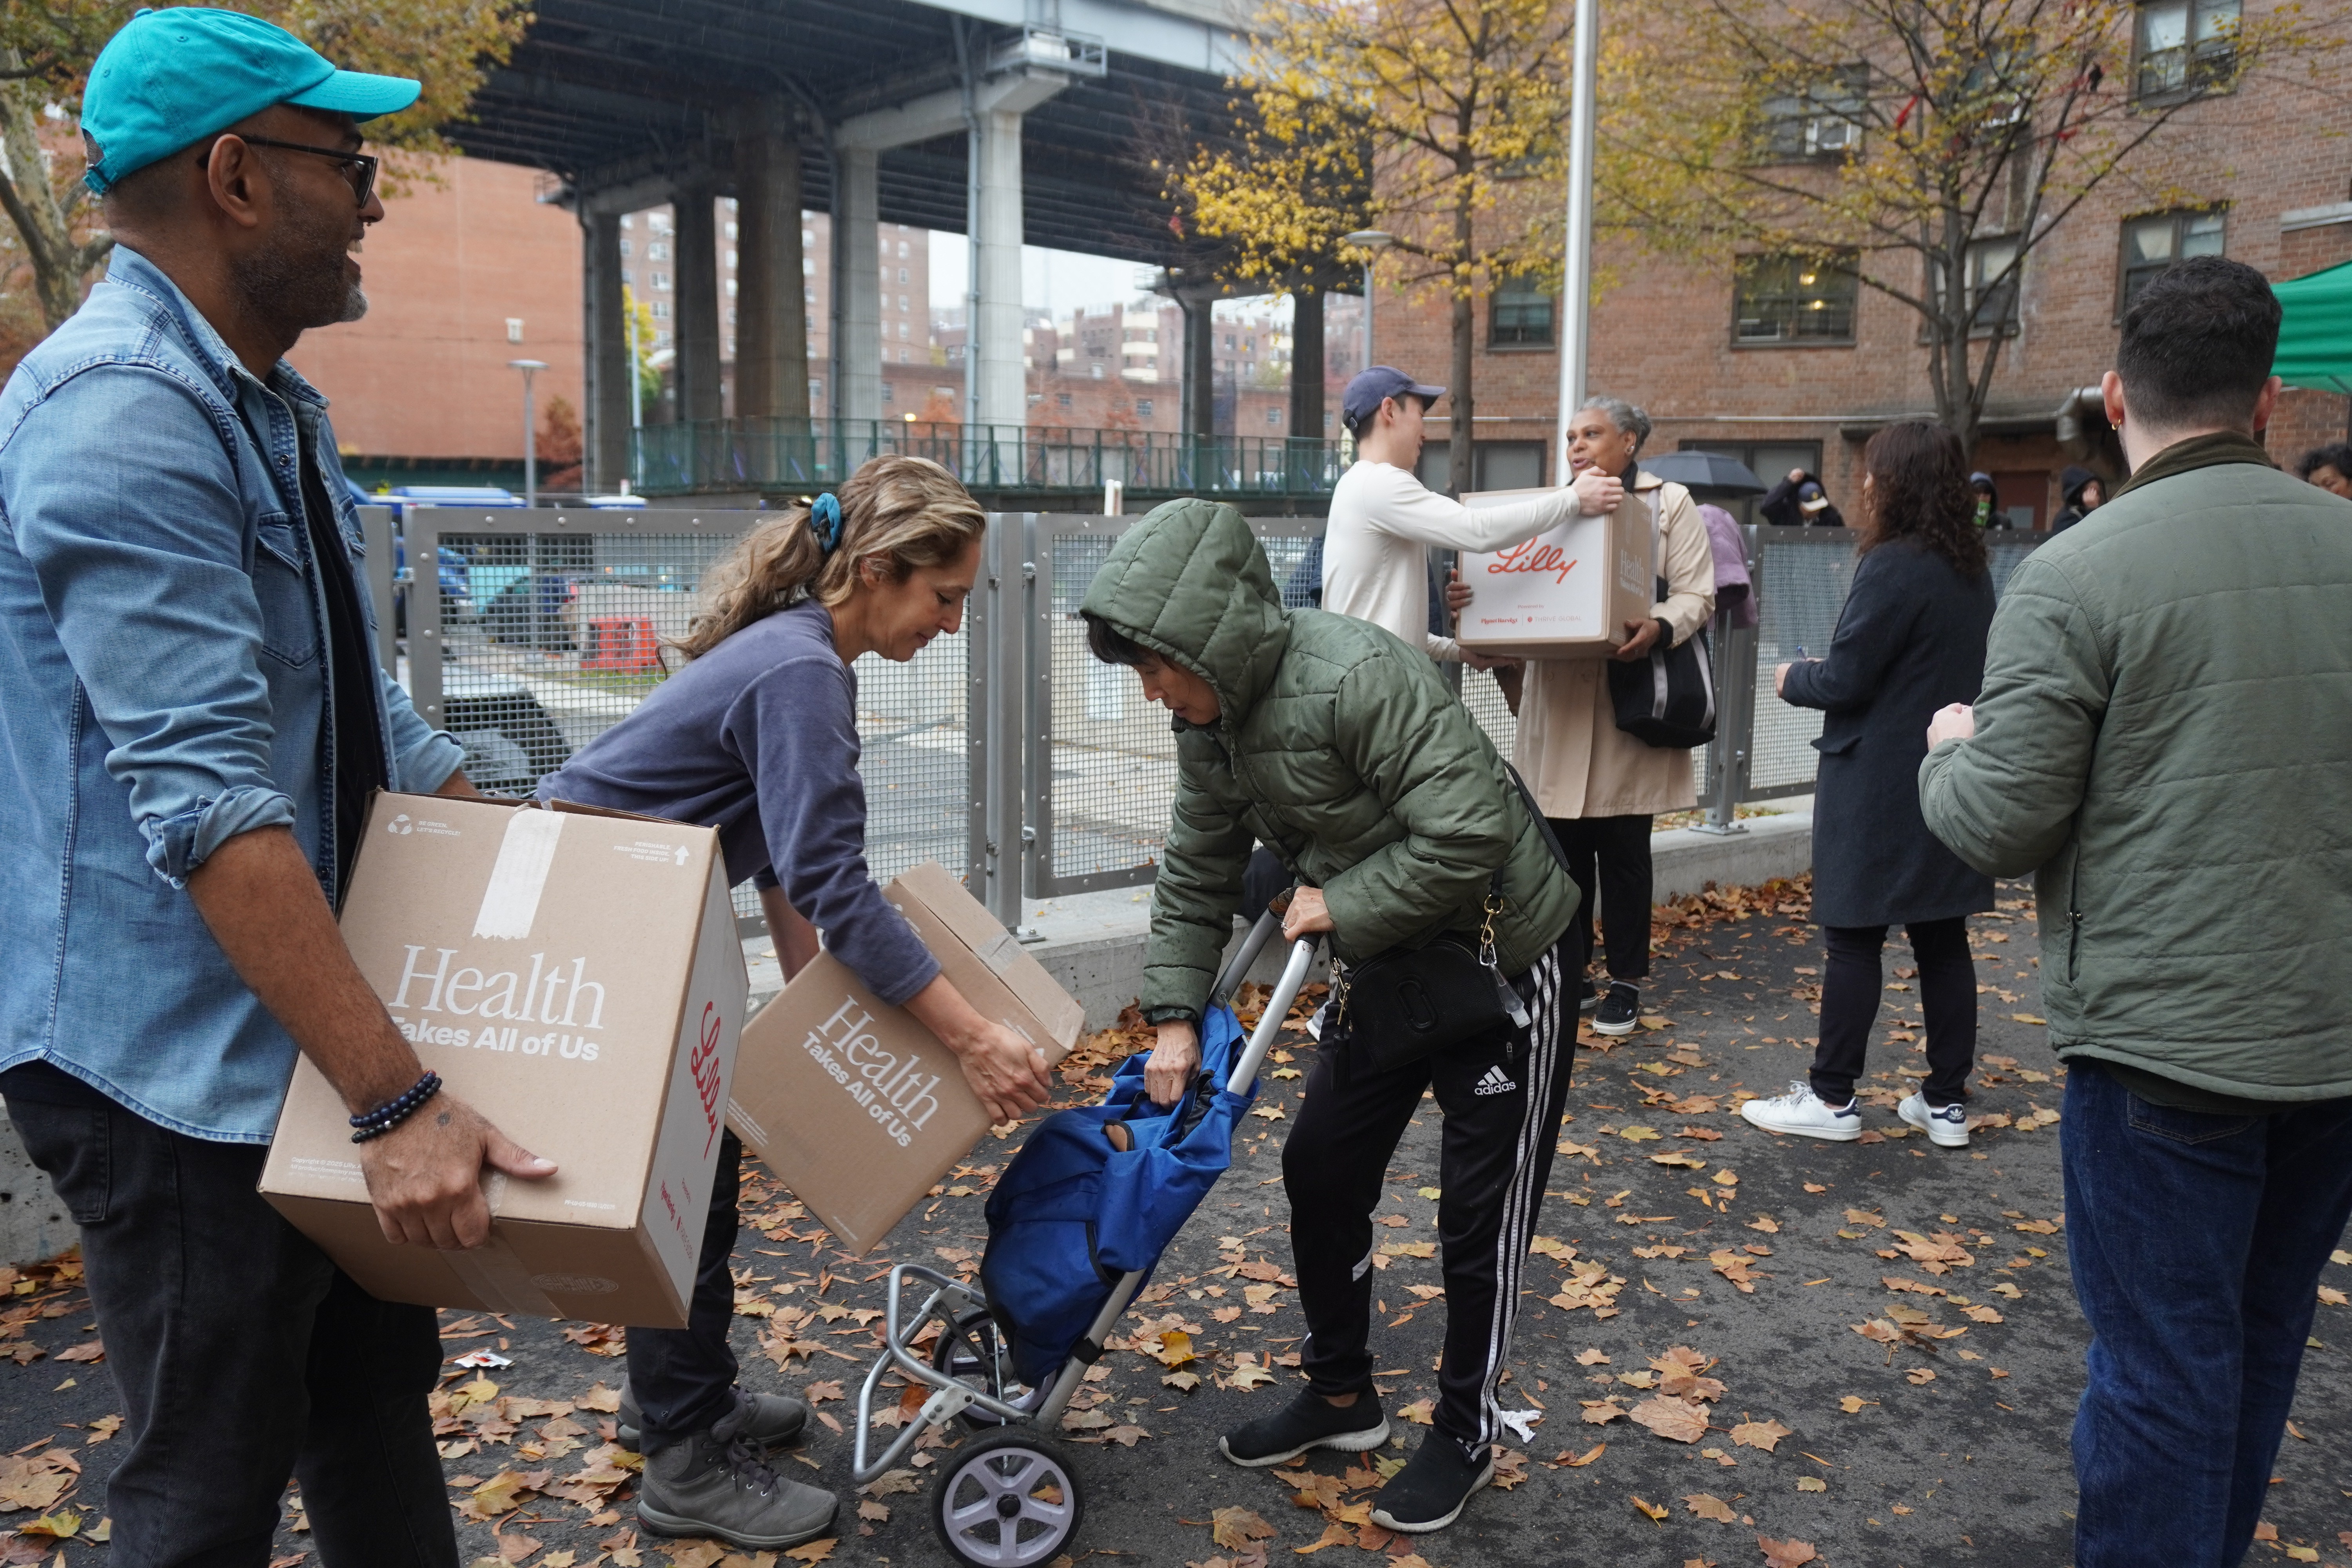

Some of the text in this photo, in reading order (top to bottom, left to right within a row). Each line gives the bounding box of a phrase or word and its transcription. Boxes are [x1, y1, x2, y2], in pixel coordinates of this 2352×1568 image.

[1488, 536, 1577, 584] Lilly
[1620, 549, 1644, 586] Health
[635, 842, 671, 850] PERISHABLE.
[388, 944, 604, 1029] Health
[473, 1026, 519, 1052] All
[521, 1032, 557, 1056] of
[559, 1034, 599, 1061] Us
[816, 994, 941, 1131] Health
[691, 1001, 720, 1161] Lilly
[802, 1031, 912, 1147] Takes All of Us
[1474, 1082, 1516, 1095] adidas
[298, 1165, 348, 1176] product/company
